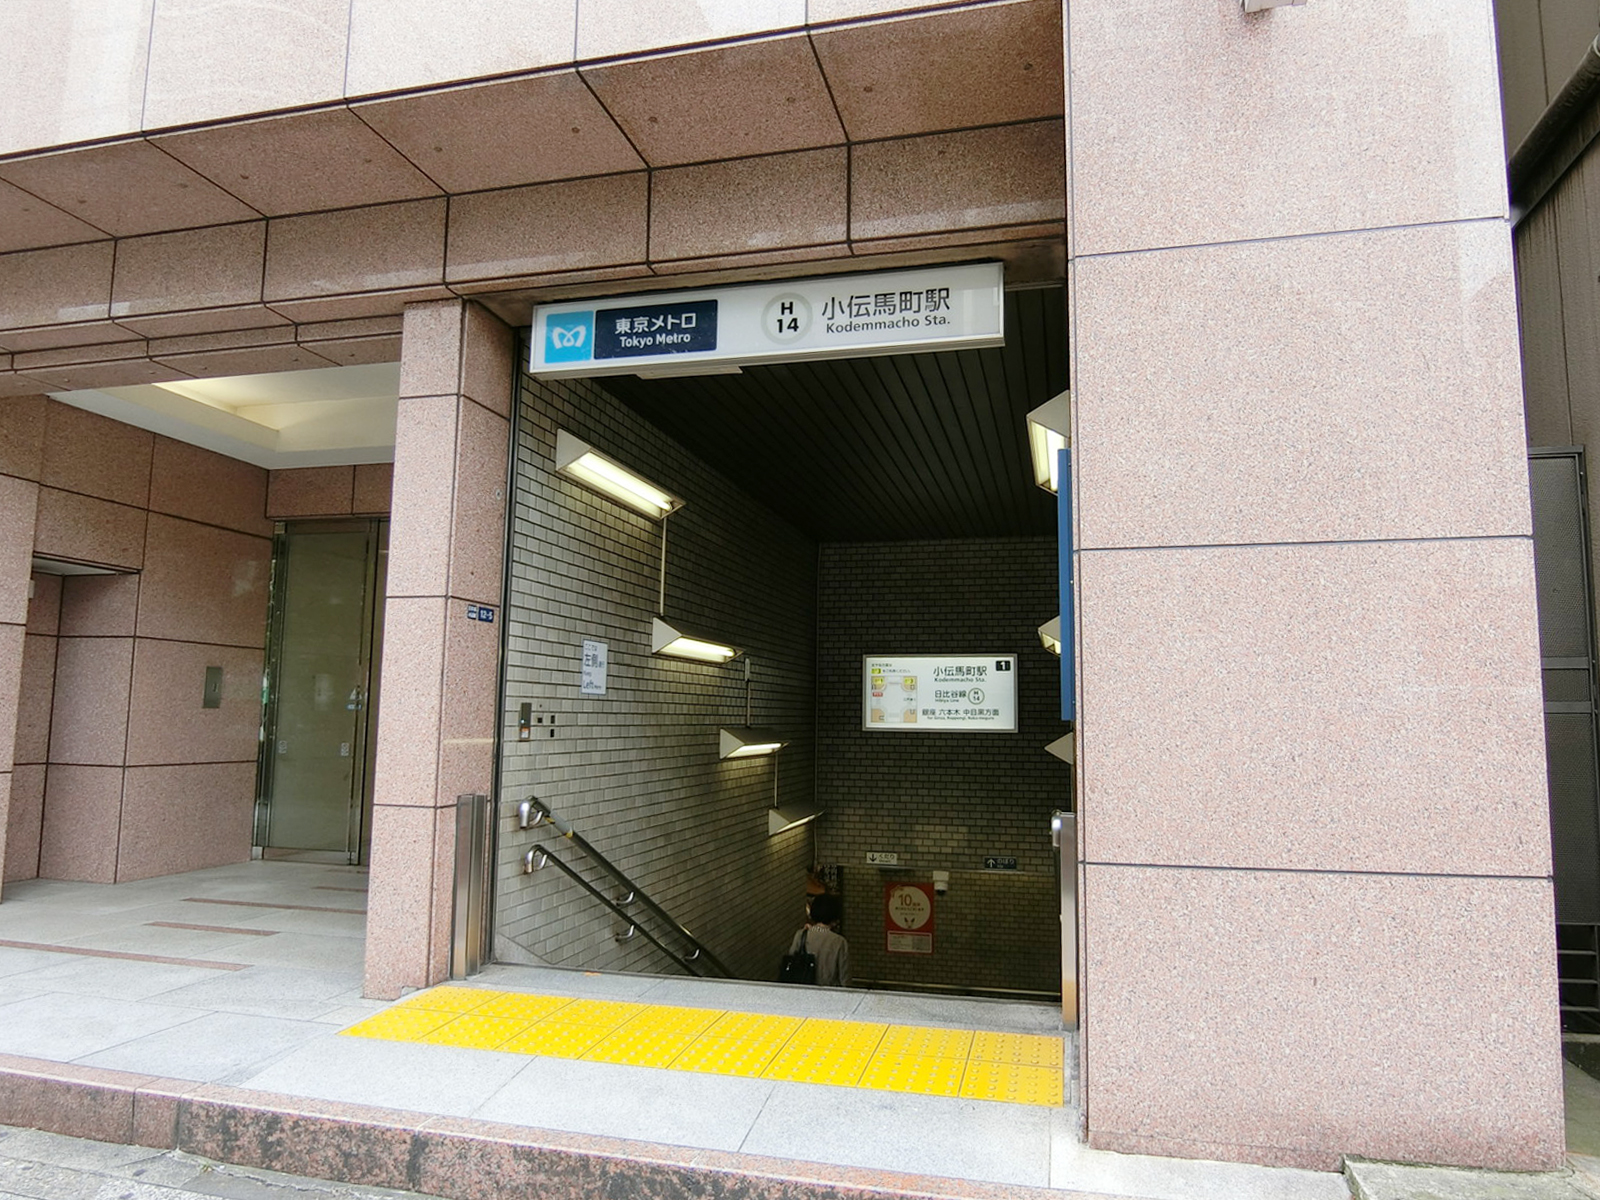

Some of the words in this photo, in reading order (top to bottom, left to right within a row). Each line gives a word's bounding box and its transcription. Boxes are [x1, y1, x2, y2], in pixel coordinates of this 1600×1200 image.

[780, 301, 794, 316] H
[821, 287, 950, 321] 小伝馬町駅
[615, 313, 696, 334] 東京メトロ
[776, 318, 800, 333] 14
[826, 316, 920, 334] Kodemmacho
[924, 315, 951, 327] Sta.
[620, 336, 653, 348] Tokyo
[656, 333, 691, 345] Metro
[480, 609, 493, 620] 12-5
[933, 665, 987, 677] 小伝馬町駅
[1000, 661, 1006, 670] 1
[934, 690, 967, 698] 日比谷線
[898, 893, 912, 906] 10
